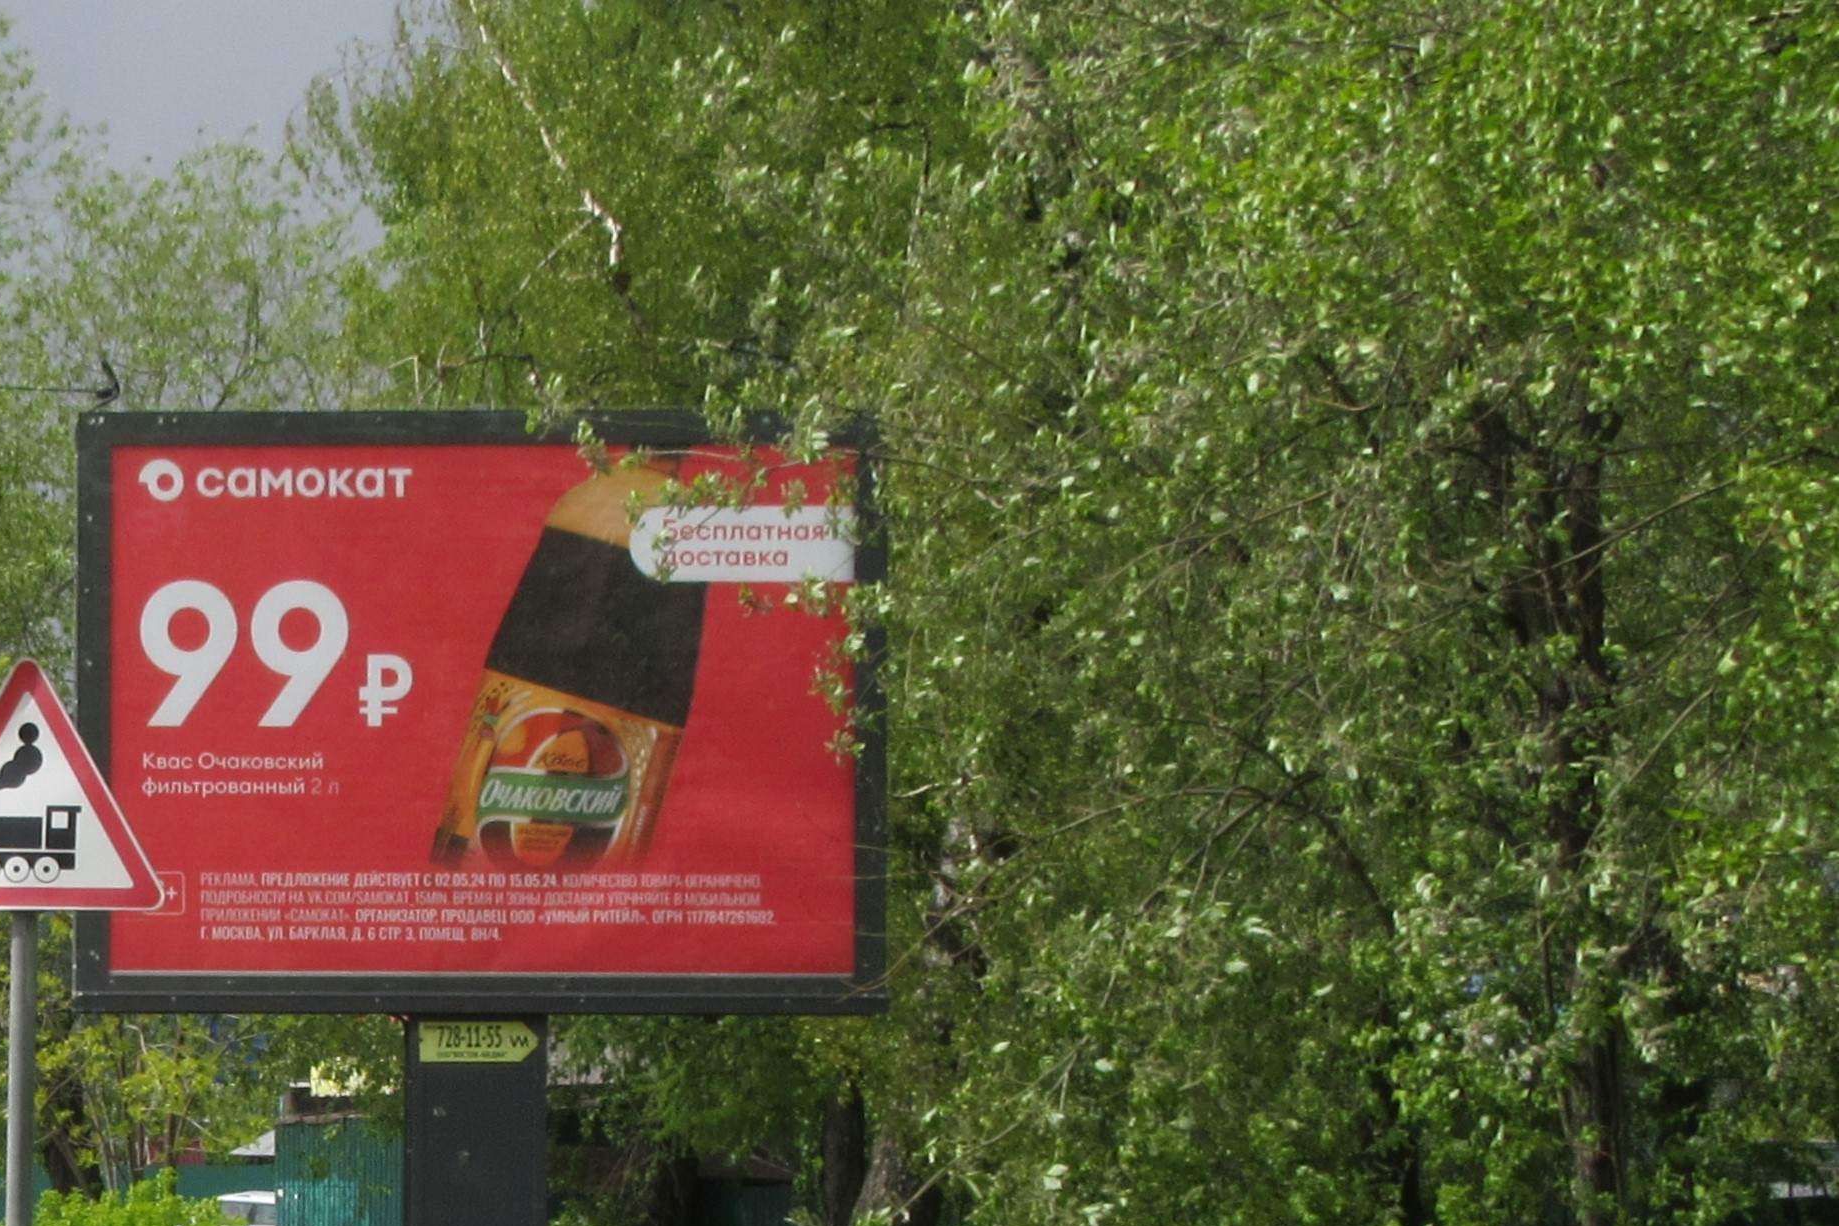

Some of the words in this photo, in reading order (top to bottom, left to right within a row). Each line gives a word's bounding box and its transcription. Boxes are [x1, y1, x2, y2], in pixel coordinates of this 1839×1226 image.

[196, 466, 413, 499] самокат
[663, 518, 827, 542] Бесплатная
[663, 550, 789, 570] доставка
[142, 752, 193, 769] Квас
[198, 752, 324, 770] Очаковский
[141, 776, 305, 798] фильтрованный
[311, 778, 322, 795] 2
[262, 872, 350, 888] ПРЕДЛОЖЕНИЕ
[354, 870, 420, 888] ДЕЙСТВУЕТ
[423, 873, 432, 887] С
[435, 873, 486, 887] 02.05.24
[488, 873, 506, 887] ПО
[563, 873, 637, 888] КОЛИЧЕСТВО
[200, 890, 285, 905] ПОДРОБНОСТИ
[289, 890, 306, 904] НА
[453, 891, 492, 905] ВРЕМЯ
[496, 891, 505, 905] И
[508, 891, 541, 906] ЗОНЫ
[544, 891, 604, 906] ДОСТАВКИ
[674, 892, 682, 906] В
[200, 908, 281, 922] ПРИЛОЖЕНИИ
[441, 909, 508, 924] ПРОДАВЕЦ
[510, 910, 535, 923] ООО
[653, 910, 683, 924] ОГРН
[367, 926, 376, 940] 6
[437, 1025, 502, 1048] 728-11-55
